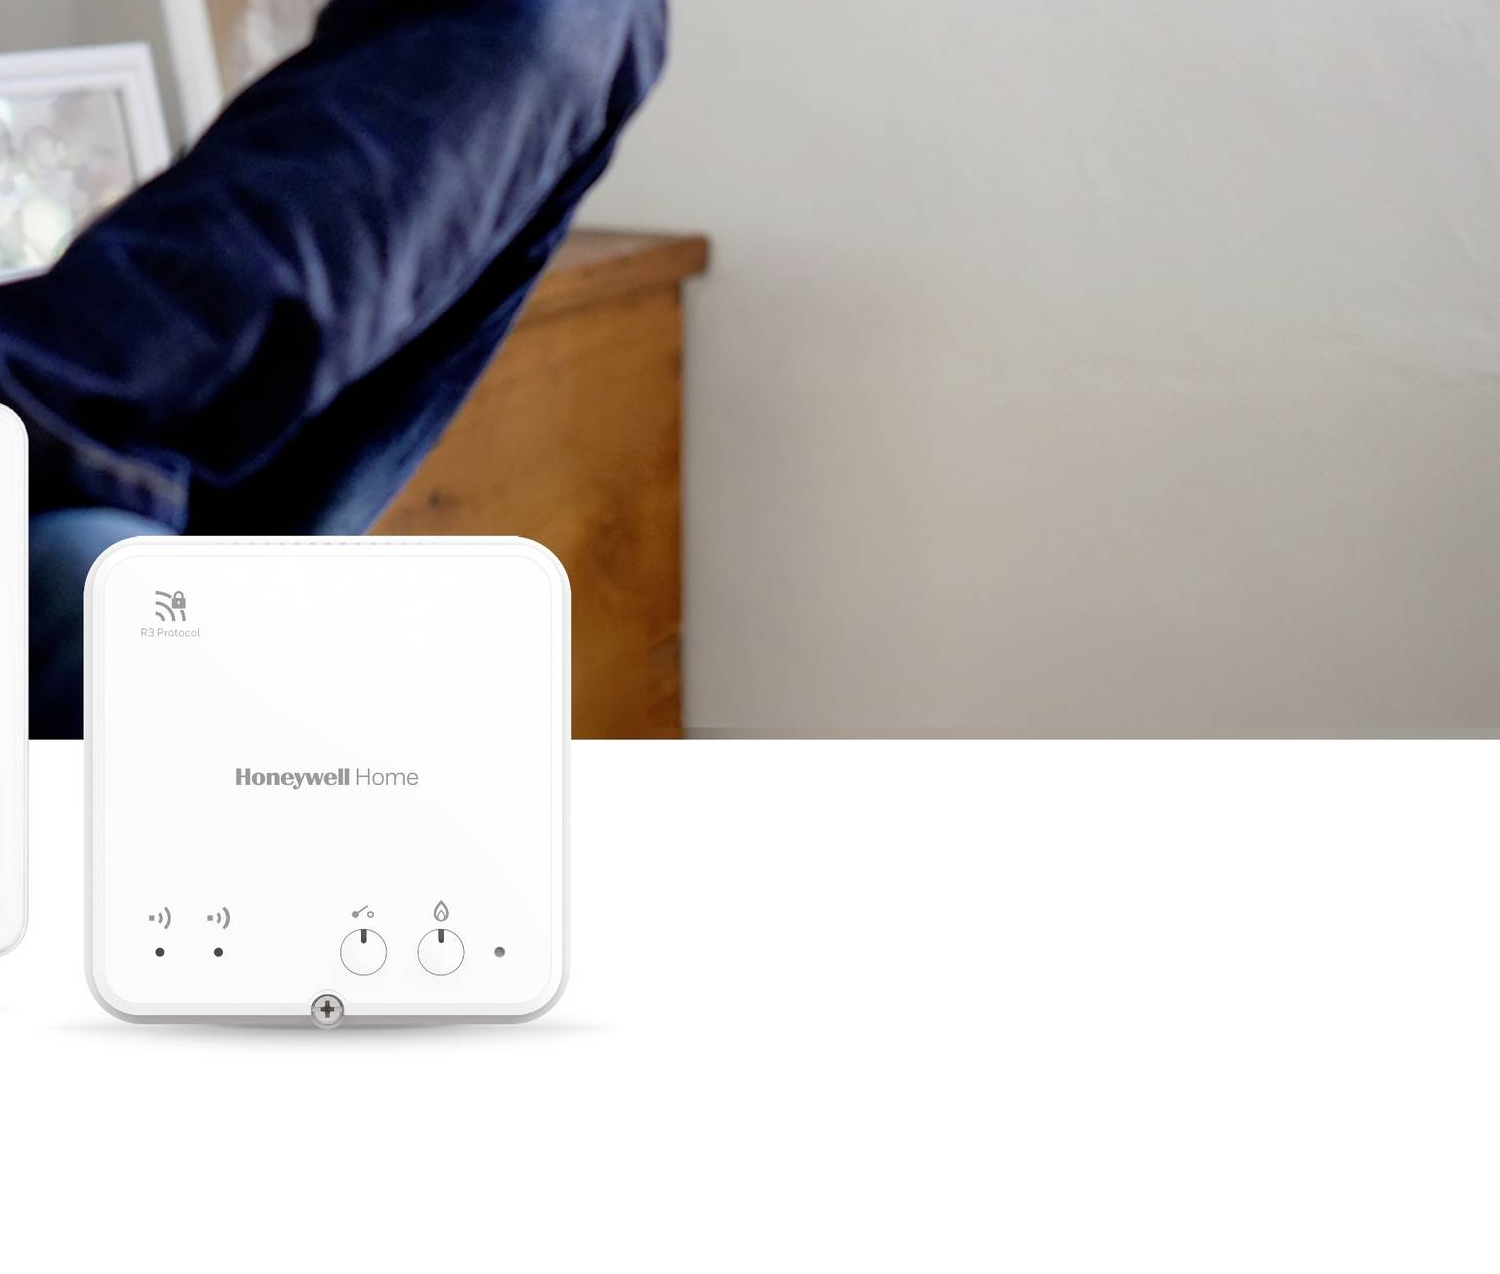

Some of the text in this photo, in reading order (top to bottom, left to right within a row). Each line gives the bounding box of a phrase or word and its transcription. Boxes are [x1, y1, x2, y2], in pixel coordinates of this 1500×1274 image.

[140, 627, 201, 638] R3 Protocol
[235, 767, 419, 791] Honeywell Home
